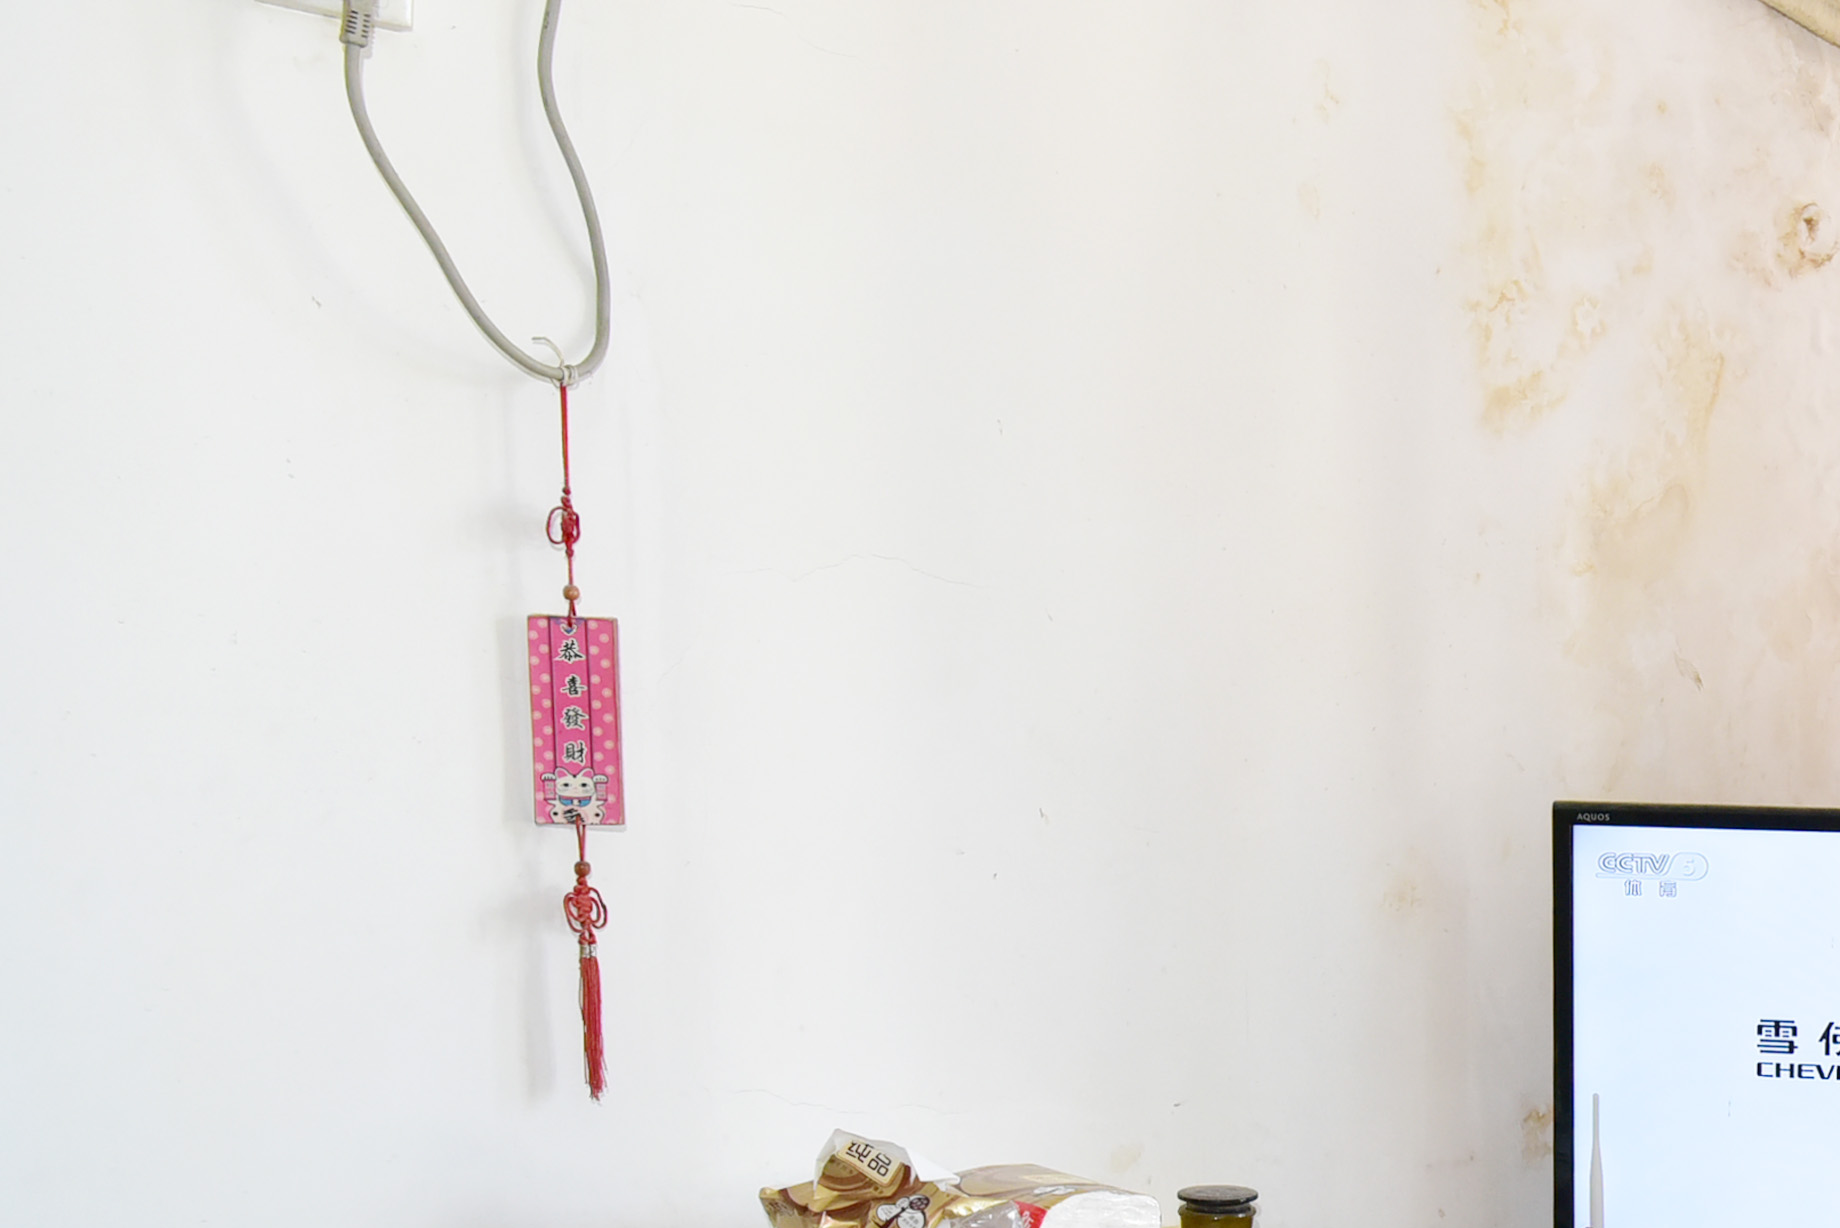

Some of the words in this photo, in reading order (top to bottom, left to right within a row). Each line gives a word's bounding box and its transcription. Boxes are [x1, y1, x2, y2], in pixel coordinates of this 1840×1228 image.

[558, 639, 588, 764] 恭喜發財
[1576, 812, 1612, 822] AQUOS
